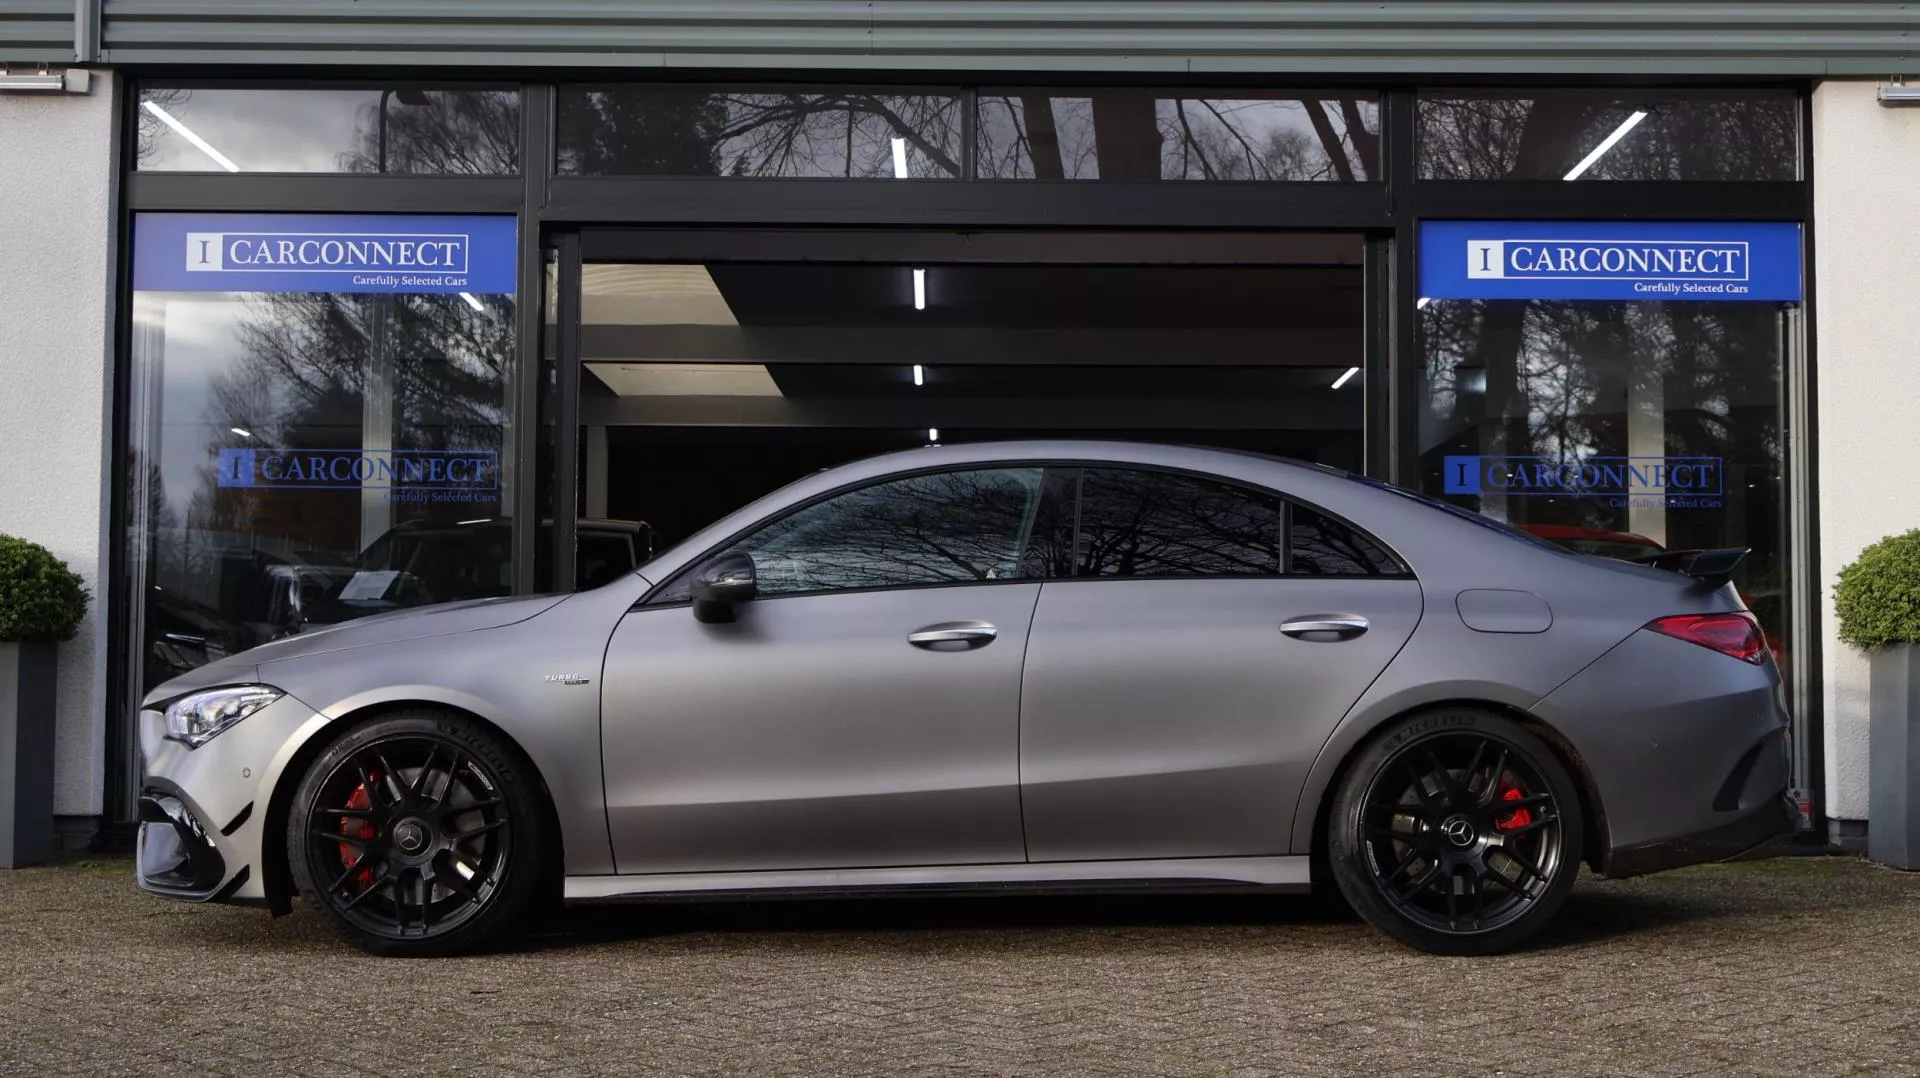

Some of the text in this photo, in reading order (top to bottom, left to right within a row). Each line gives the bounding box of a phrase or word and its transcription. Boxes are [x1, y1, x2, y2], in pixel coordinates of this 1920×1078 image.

[199, 240, 460, 266] I CARCONNECT
[1480, 247, 1740, 274] I CARCONNECT
[352, 274, 468, 288] Carefully Selected Cars
[1634, 282, 1749, 296] Carefully Selected Cars
[261, 456, 489, 483] CARCONNECT
[1486, 463, 1714, 489] CARCONNECT
